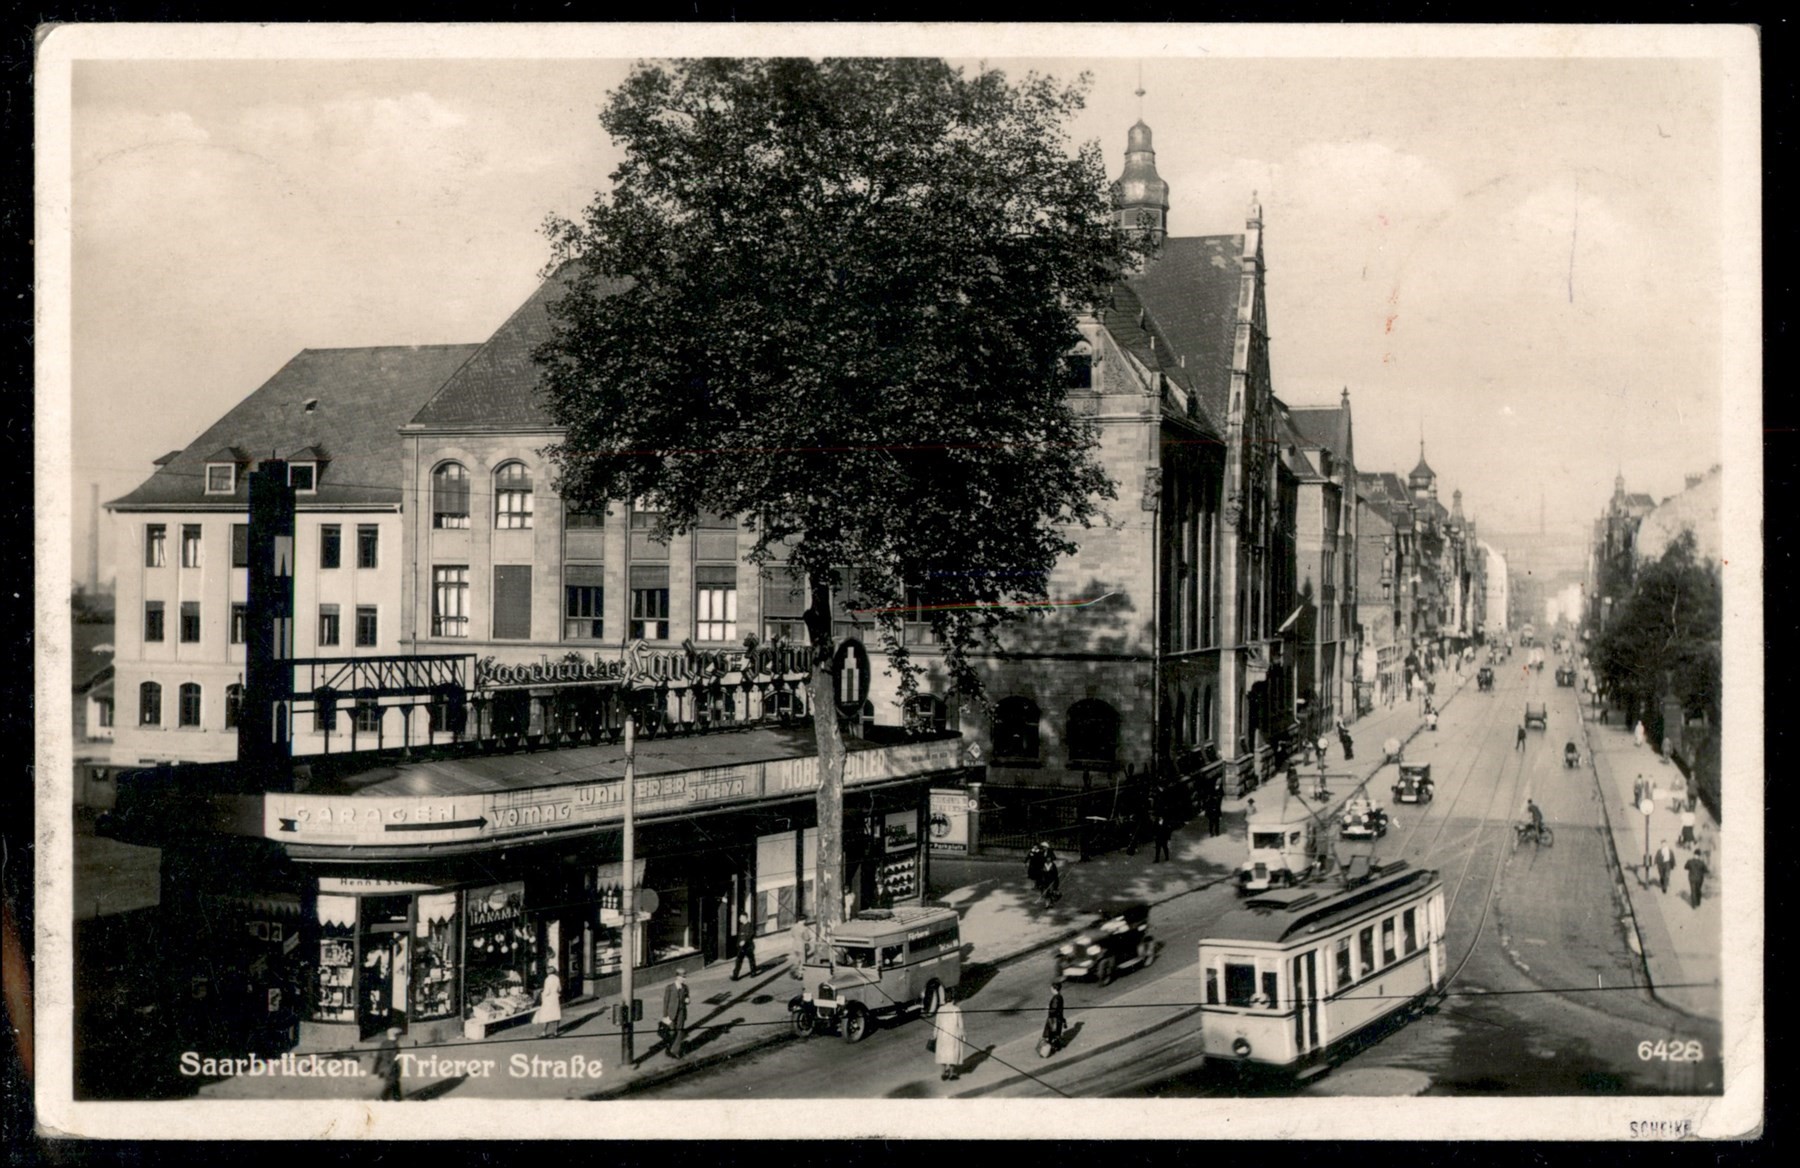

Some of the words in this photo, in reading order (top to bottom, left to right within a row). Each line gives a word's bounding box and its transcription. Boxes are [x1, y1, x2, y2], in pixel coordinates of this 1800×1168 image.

[576, 776, 687, 804] WANERER
[296, 805, 456, 822] GARAGEN
[492, 803, 573, 828] VOMAG
